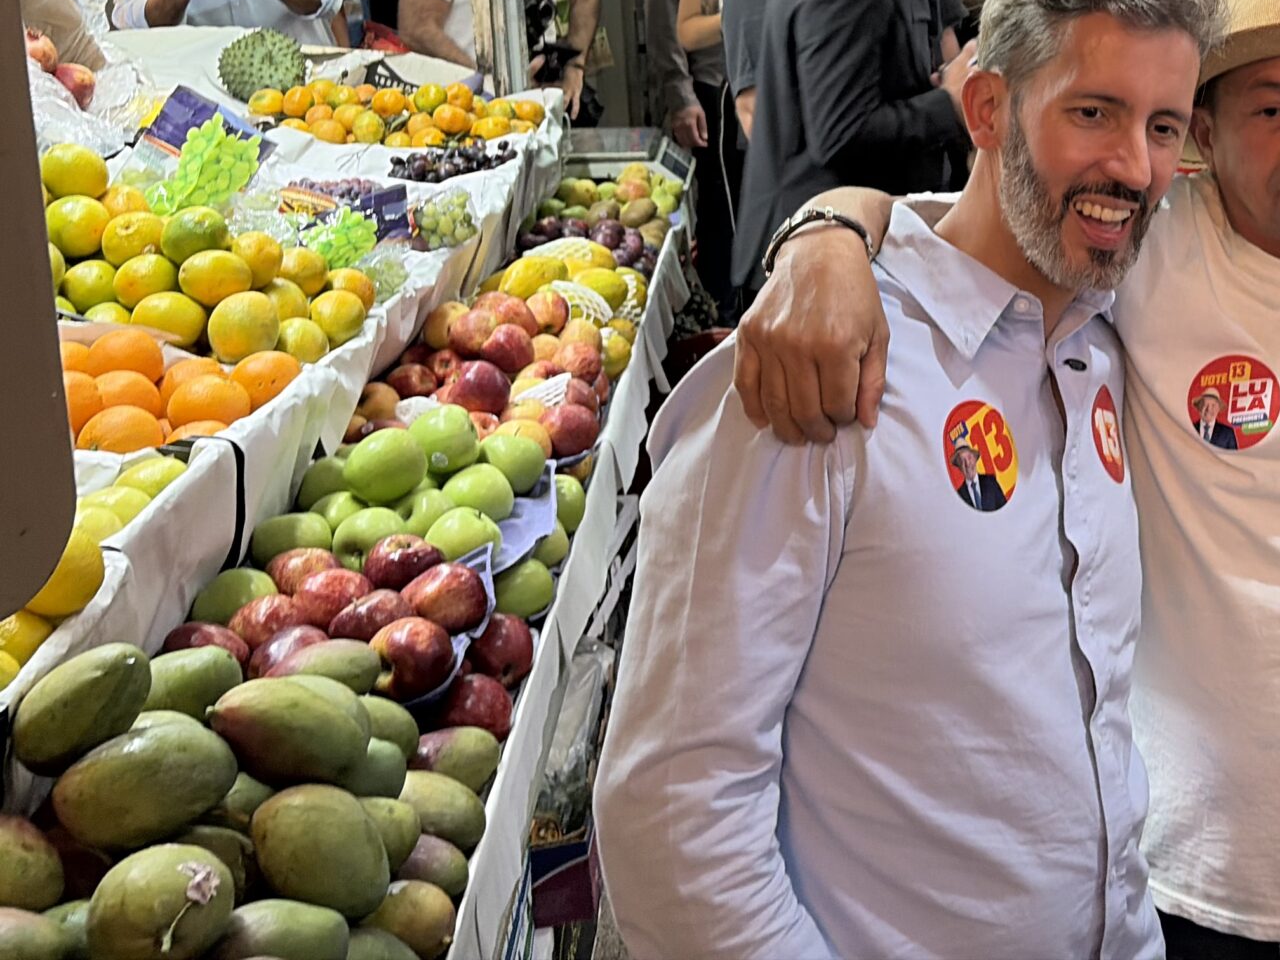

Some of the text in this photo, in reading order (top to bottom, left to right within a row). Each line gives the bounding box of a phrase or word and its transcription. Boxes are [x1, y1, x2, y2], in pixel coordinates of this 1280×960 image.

[1200, 364, 1246, 387] VOTE 13
[969, 409, 1013, 476] 13
[1094, 407, 1121, 466] 13
